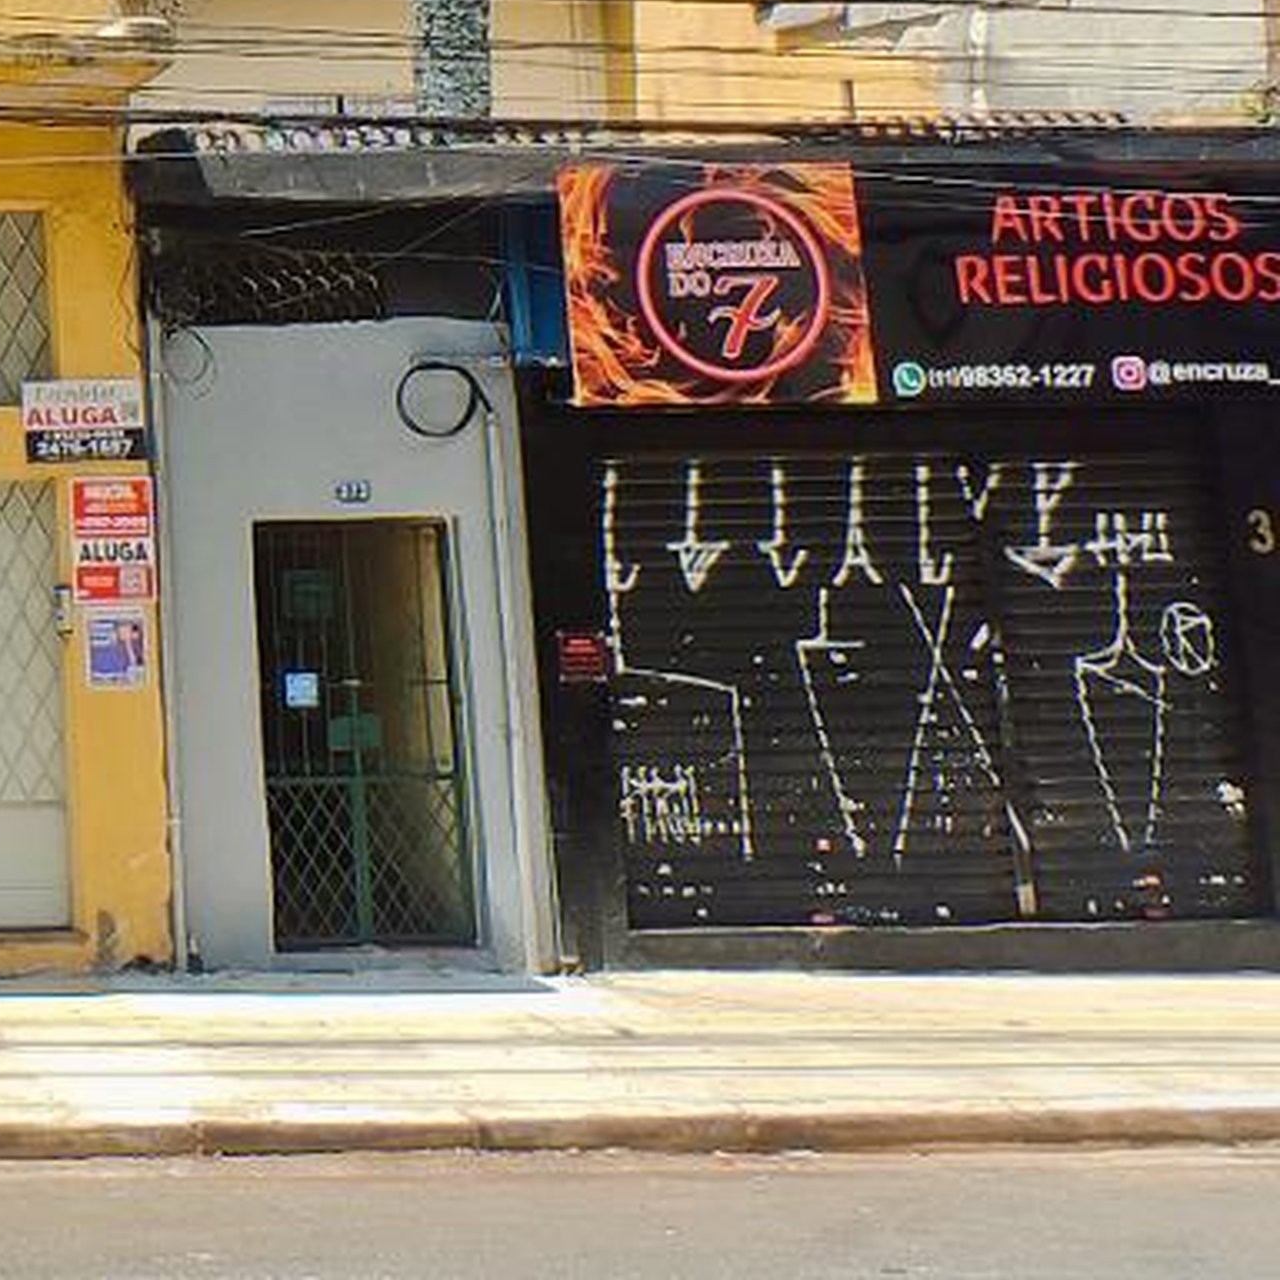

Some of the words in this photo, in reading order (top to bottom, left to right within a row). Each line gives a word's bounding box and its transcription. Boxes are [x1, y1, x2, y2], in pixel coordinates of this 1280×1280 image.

[991, 192, 1240, 242] ARTIGOS
[955, 252, 1280, 303] RELIGIOSOS
[27, 406, 118, 427] ALUGA
[79, 542, 148, 562] ALUGA
